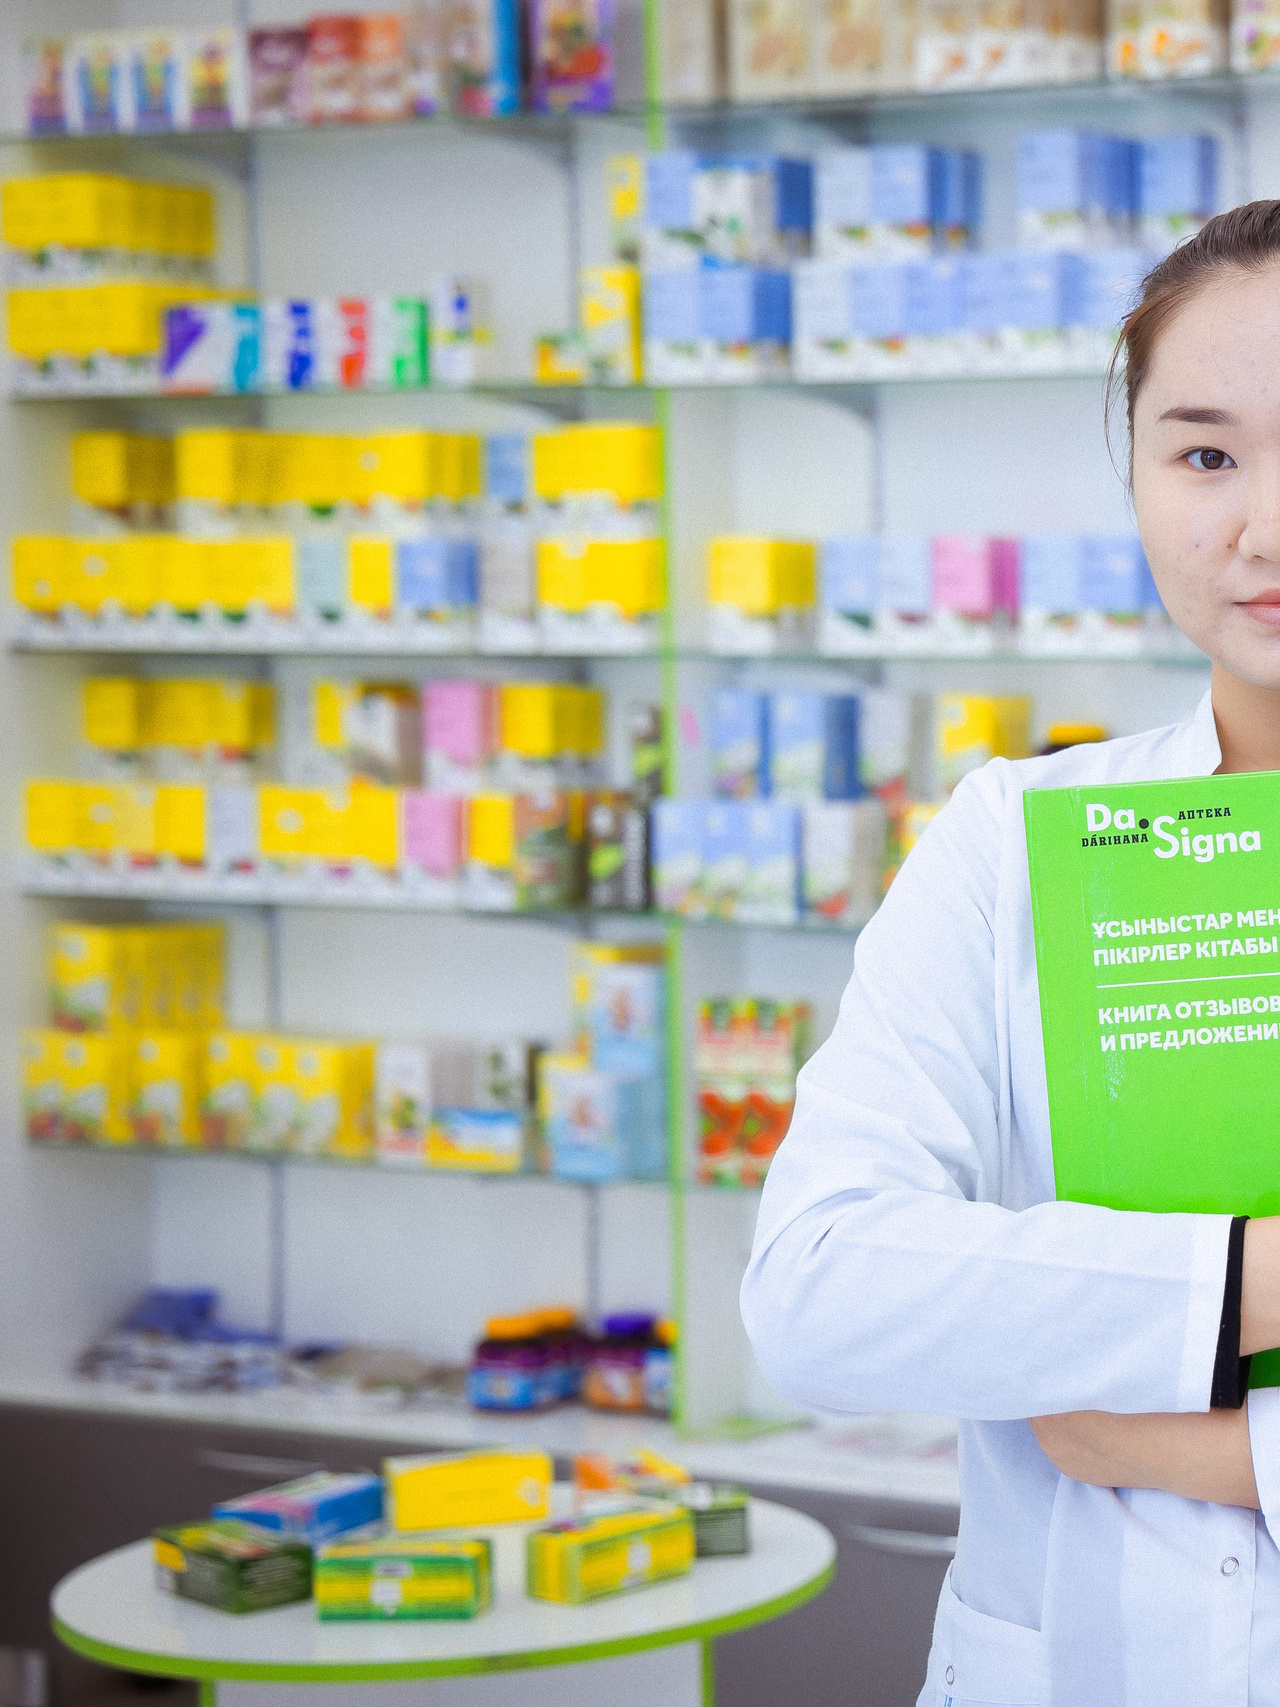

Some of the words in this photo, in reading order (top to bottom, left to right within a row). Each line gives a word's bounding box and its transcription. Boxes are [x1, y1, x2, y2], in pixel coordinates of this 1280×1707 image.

[1178, 807, 1232, 821] АПТЕКА
[1081, 833, 1149, 848] DÁRIHANA
[1152, 815, 1262, 863] Signa
[1092, 913, 1232, 938] ҰСЫНЫСТАР
[1093, 943, 1192, 967] ПІКІРЛЕР
[1196, 936, 1279, 959] КІТАБЫ
[1098, 1004, 1172, 1025] КНИГА
[1100, 1035, 1116, 1052] И
